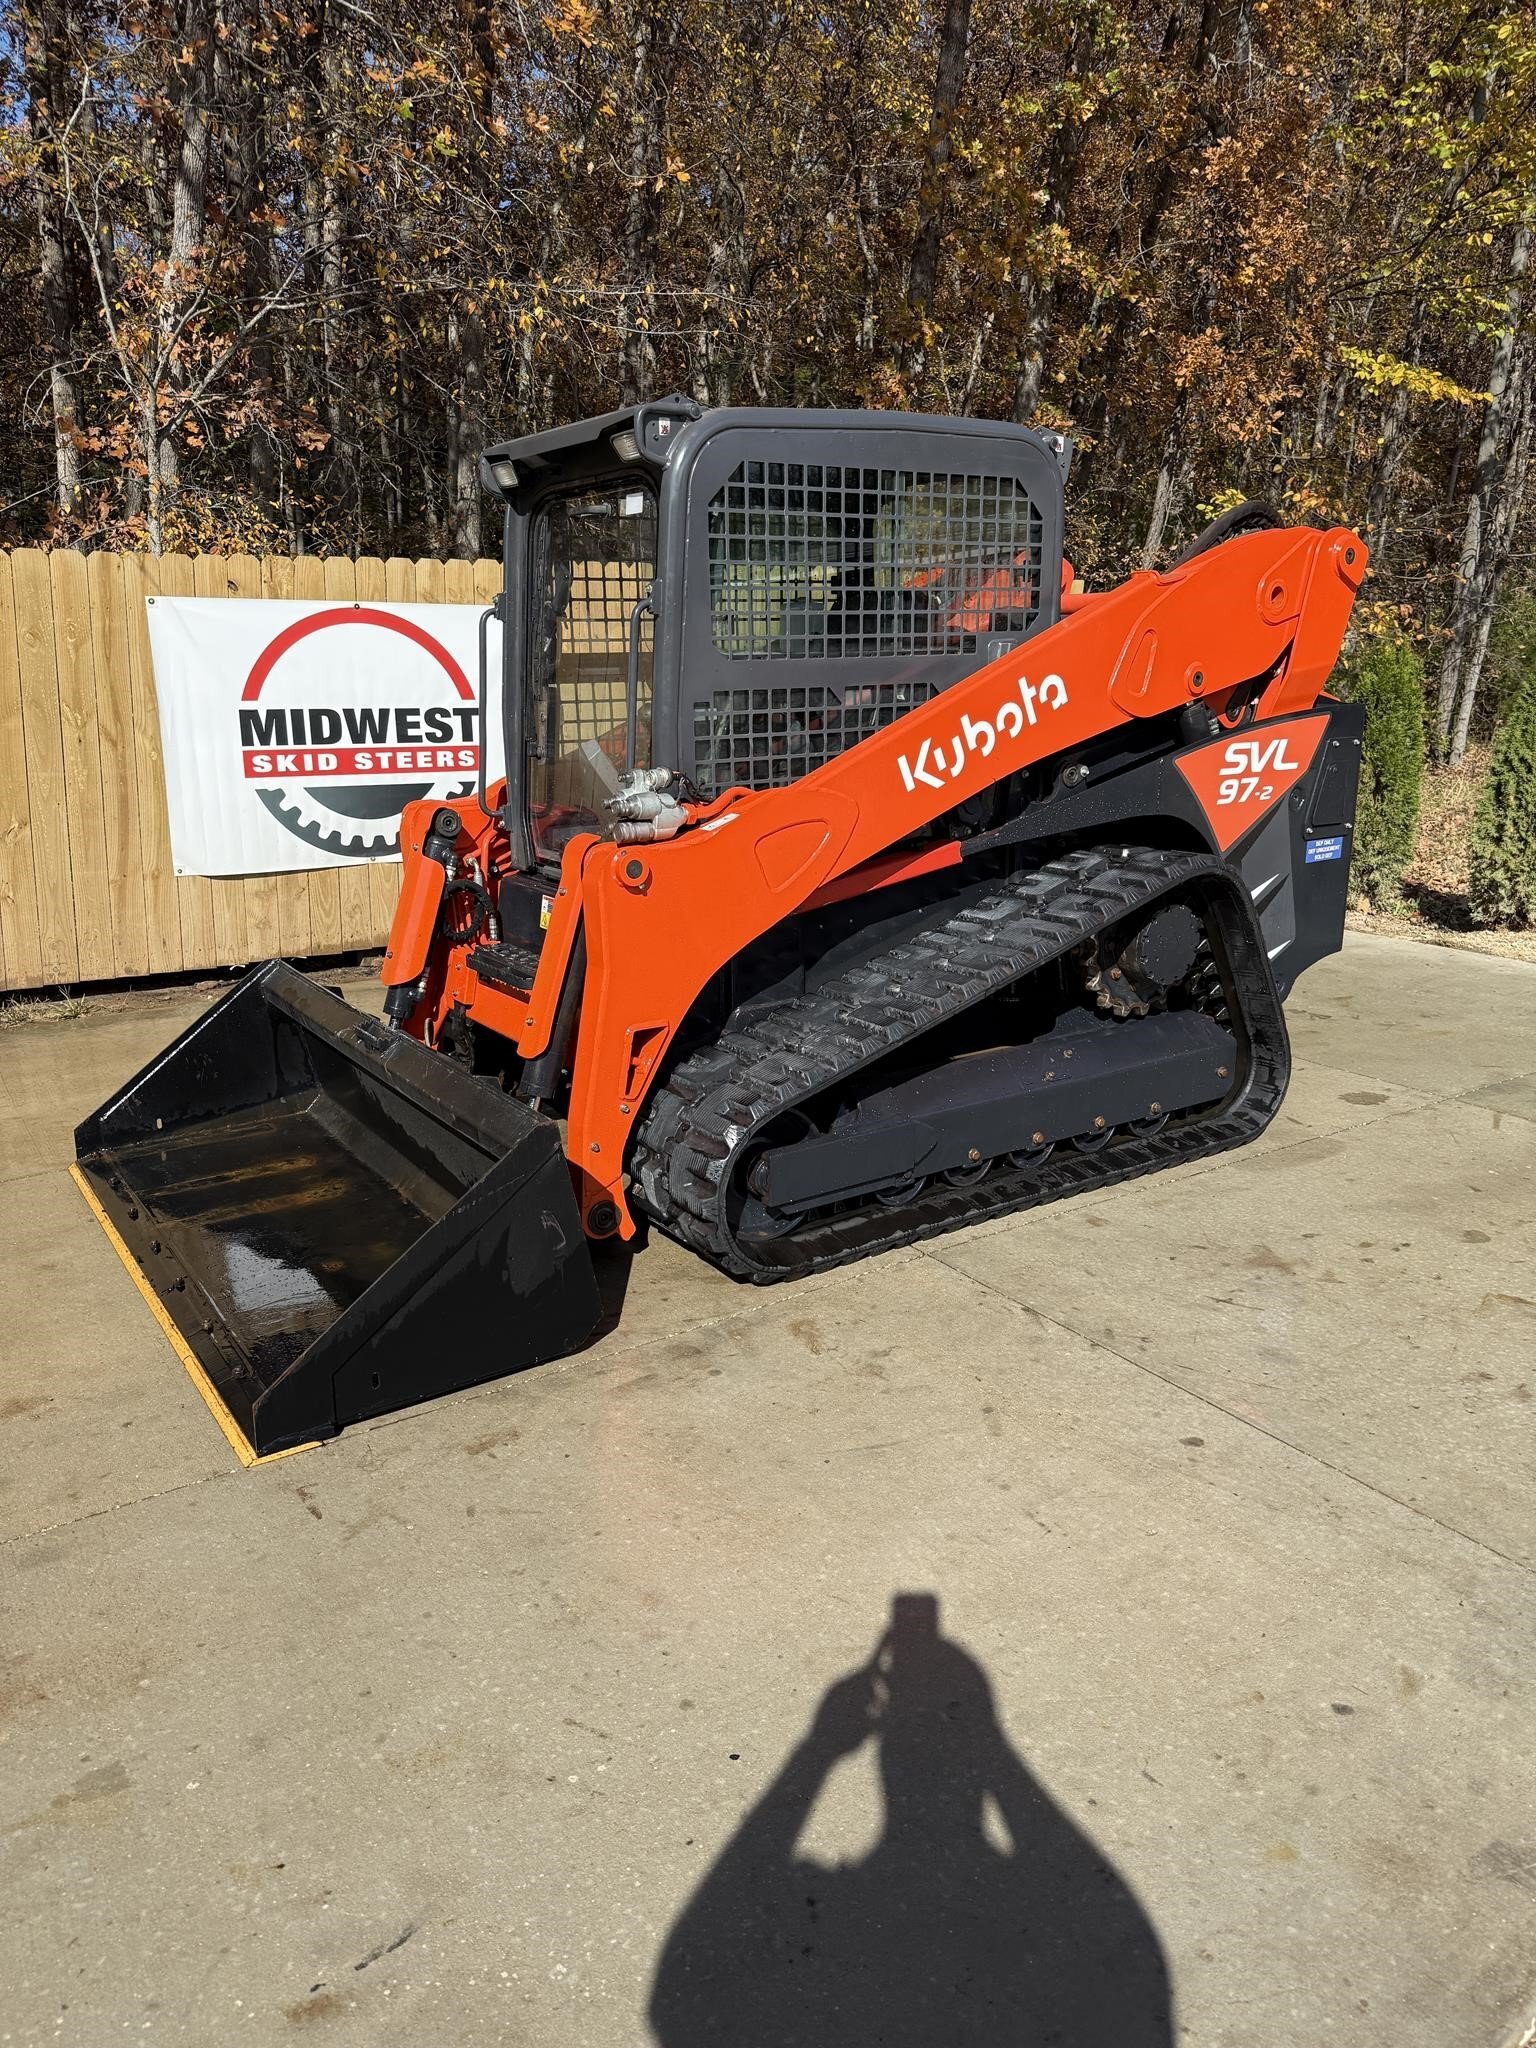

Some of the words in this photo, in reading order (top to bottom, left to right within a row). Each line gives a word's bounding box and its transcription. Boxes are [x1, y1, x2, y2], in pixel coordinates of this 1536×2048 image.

[238, 707, 479, 747] MIDWEST
[897, 674, 1069, 793] Kubota
[251, 753, 338, 773] SKID
[354, 750, 476, 770] STEERS
[1219, 738, 1298, 776] SVL
[1216, 776, 1274, 805] 97-2
